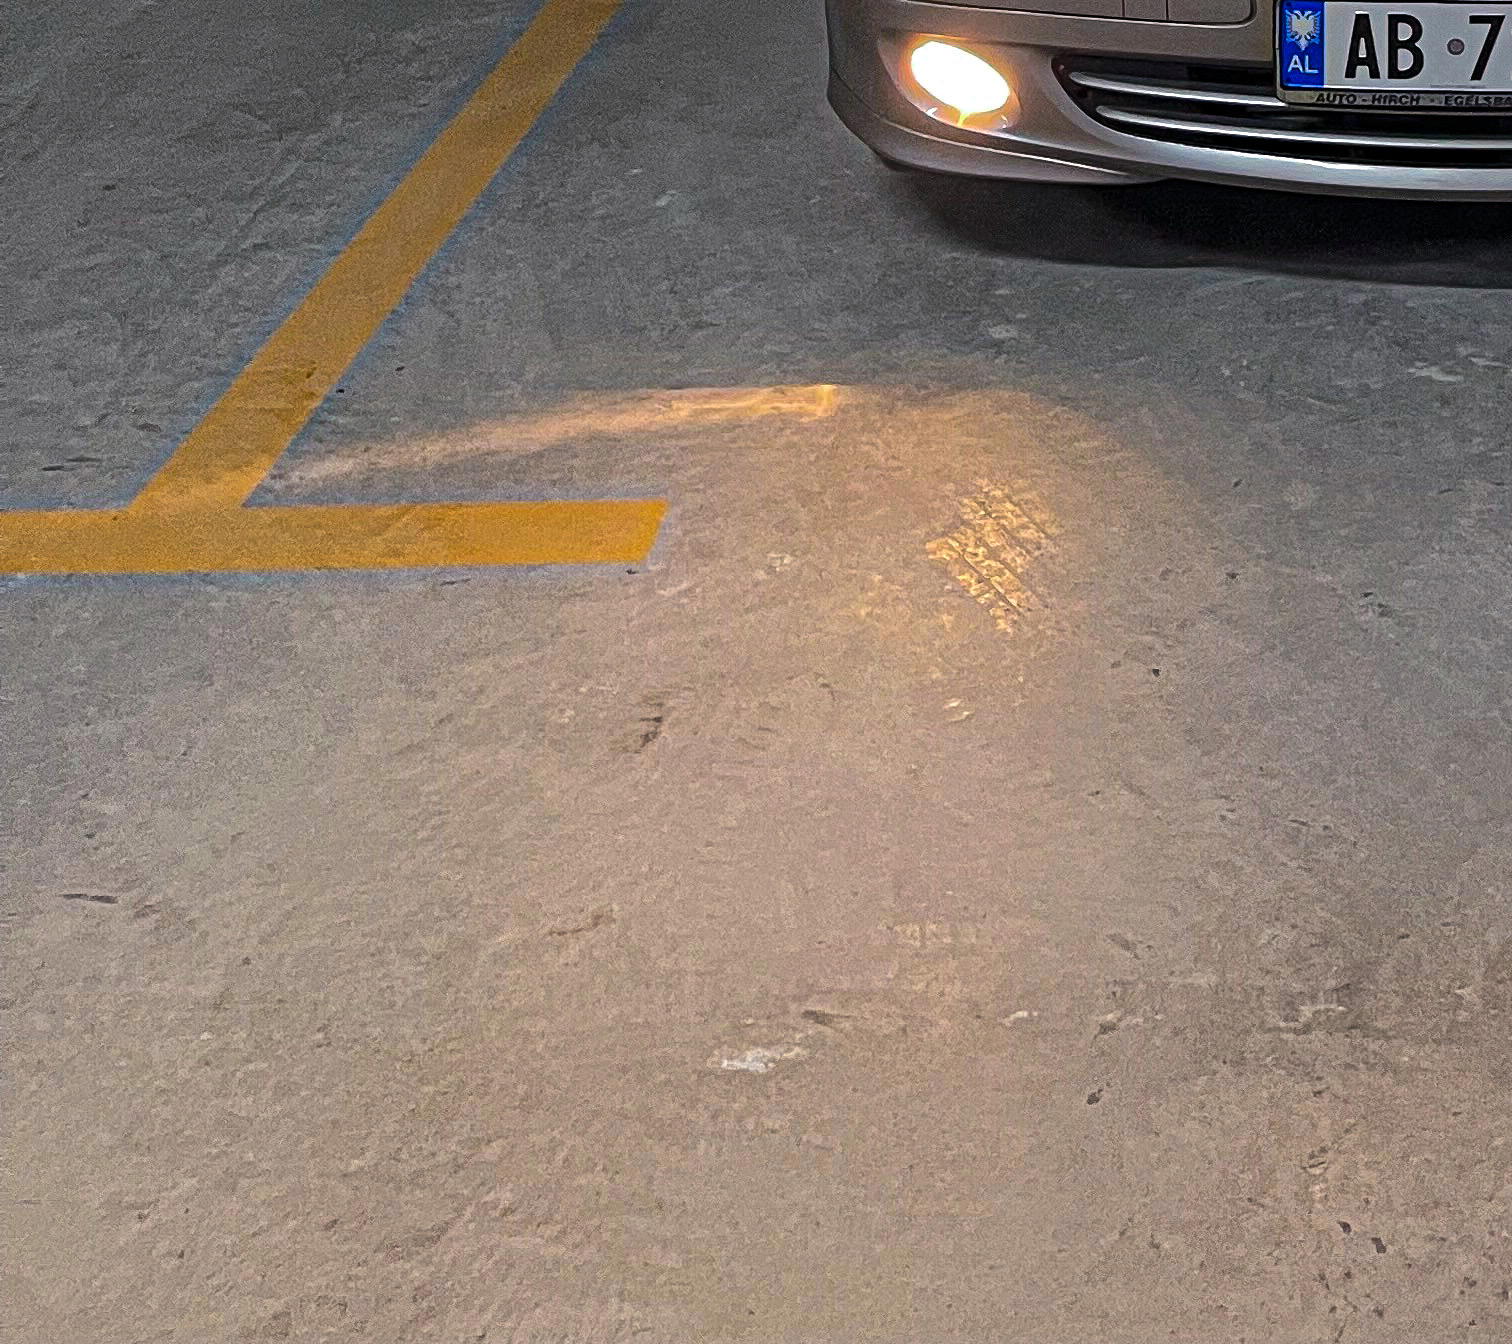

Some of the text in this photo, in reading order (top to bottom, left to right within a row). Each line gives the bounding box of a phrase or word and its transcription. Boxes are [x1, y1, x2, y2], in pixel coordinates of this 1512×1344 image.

[1343, 12, 1425, 80] AB
[1287, 55, 1319, 74] AL
[1315, 92, 1357, 105] AUTO
